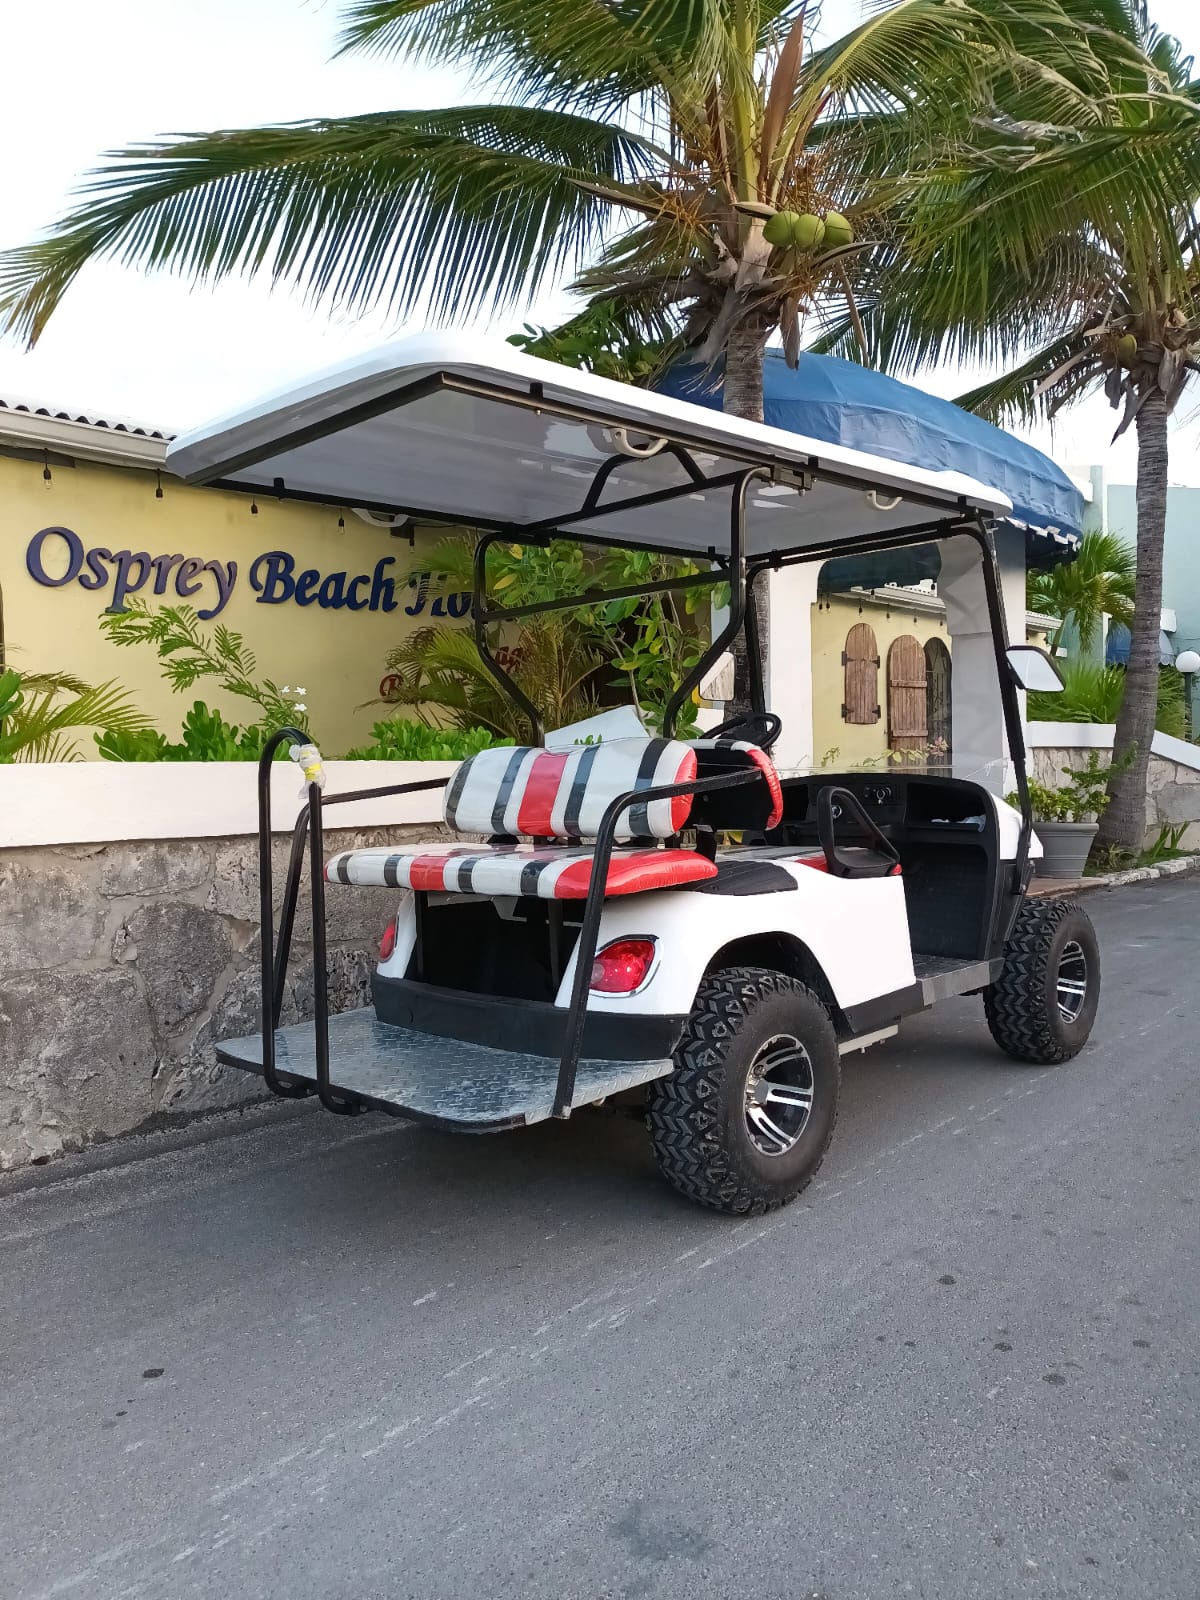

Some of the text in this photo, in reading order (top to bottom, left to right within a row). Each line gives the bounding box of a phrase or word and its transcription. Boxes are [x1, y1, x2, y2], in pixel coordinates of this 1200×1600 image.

[26, 526, 475, 620] Osprey Beach Ho
